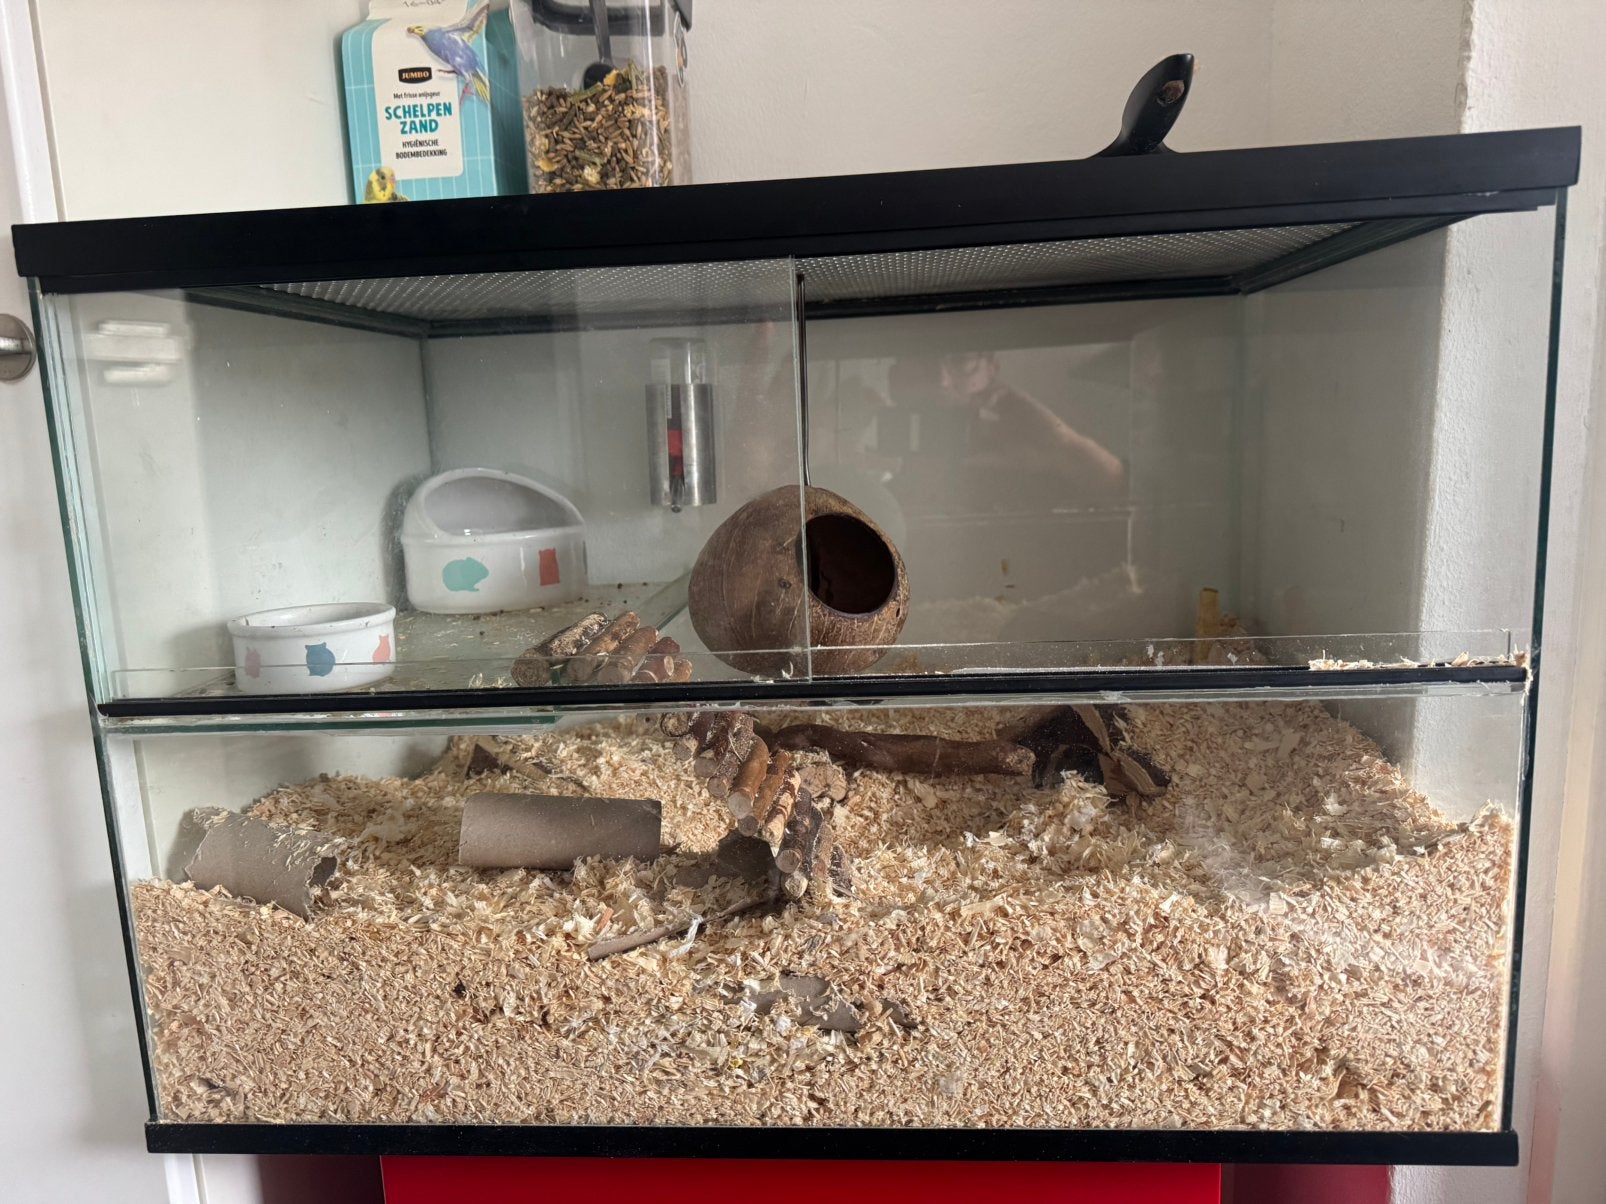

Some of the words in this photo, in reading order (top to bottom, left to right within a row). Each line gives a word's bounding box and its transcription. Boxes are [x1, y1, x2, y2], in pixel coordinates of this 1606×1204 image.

[402, 71, 429, 79] JUMBO
[385, 102, 452, 120] SCHELPEN
[400, 119, 439, 134] ZAND
[402, 138, 439, 148] HYGIËNISCHE
[395, 149, 447, 159] BODEMBEDEKKING
